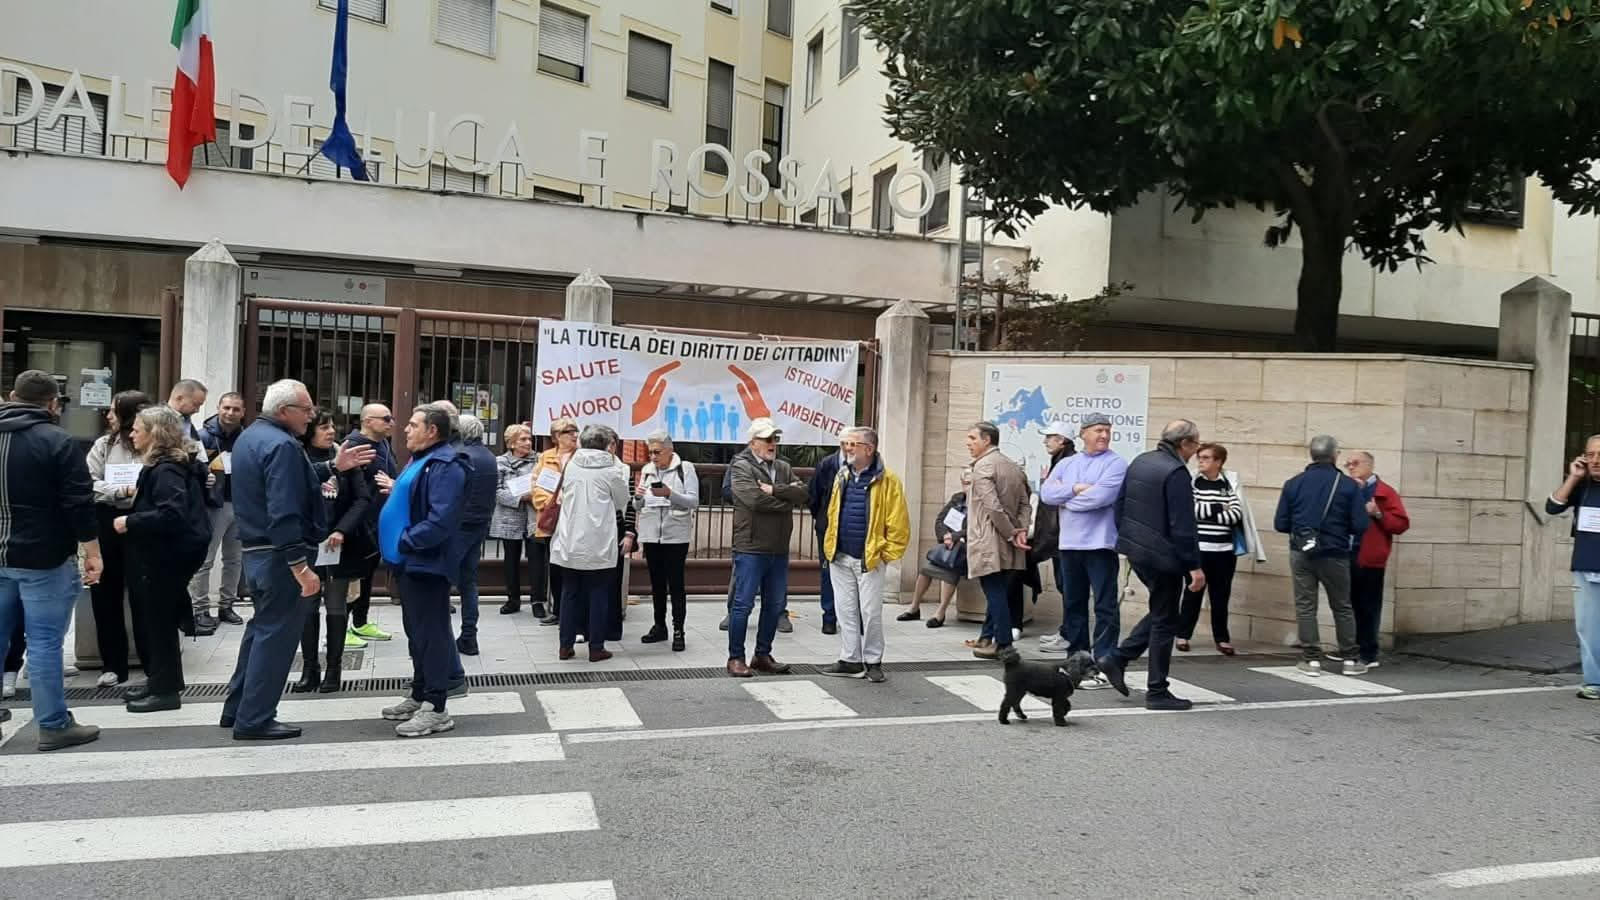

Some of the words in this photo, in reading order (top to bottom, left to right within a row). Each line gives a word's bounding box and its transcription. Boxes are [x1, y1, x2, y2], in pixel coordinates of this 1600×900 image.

[231, 88, 314, 157] DE
[361, 107, 528, 177] LUCA
[580, 129, 609, 187] E
[544, 327, 571, 346] "LA
[577, 329, 641, 351] TUTELA
[648, 335, 674, 357] DEI
[680, 341, 738, 361] DIRITTI
[743, 343, 769, 362] DEI
[772, 344, 853, 364] CITTADINI"
[541, 358, 621, 386] SALUTE
[784, 365, 855, 405] ISTRUZIONE
[548, 395, 622, 422] LAVORO
[1065, 396, 1122, 410] CENTRO
[777, 400, 846, 437] AMBIENTE
[1043, 412, 1145, 427] VACCIIONE
[1126, 432, 1141, 443] 19
